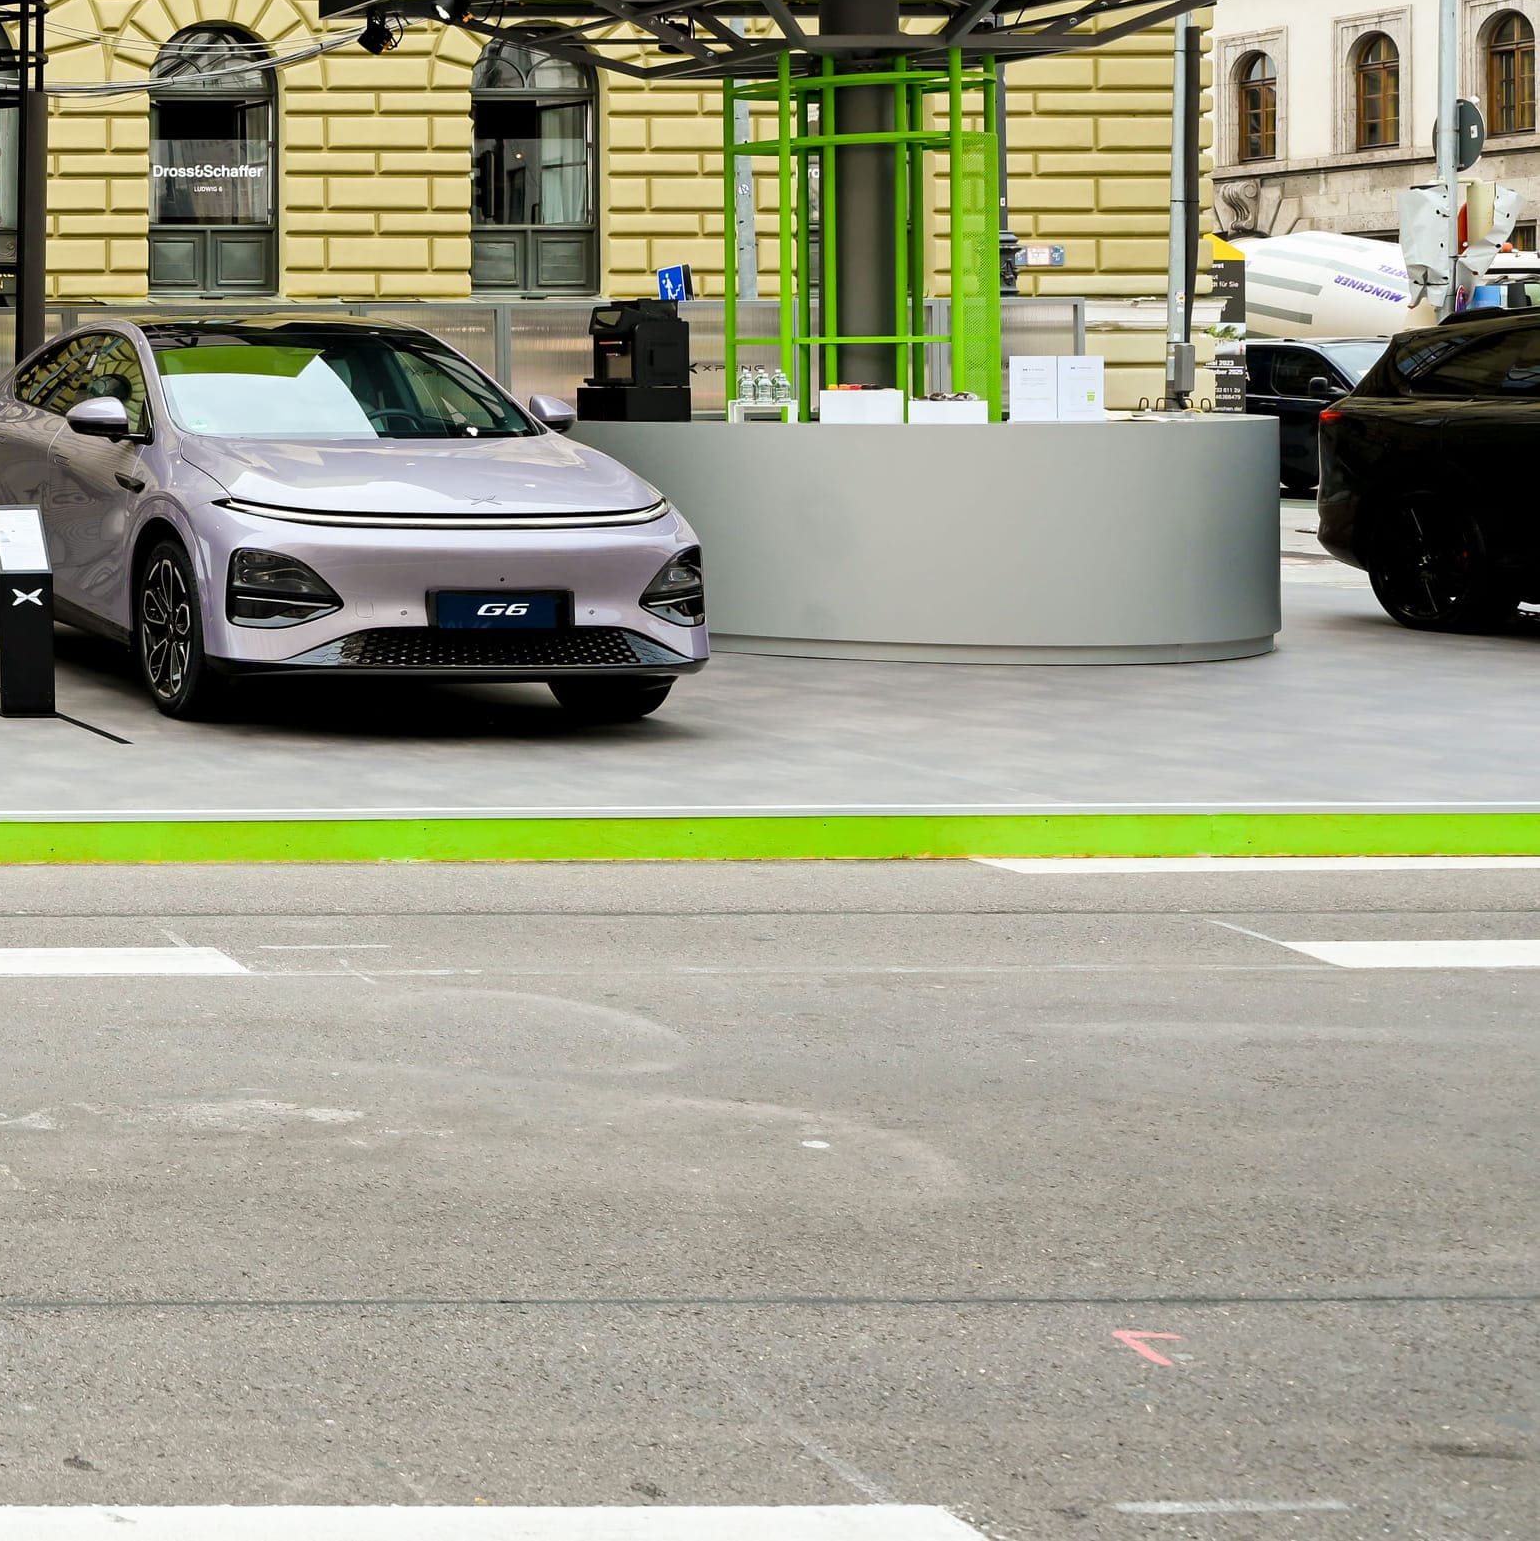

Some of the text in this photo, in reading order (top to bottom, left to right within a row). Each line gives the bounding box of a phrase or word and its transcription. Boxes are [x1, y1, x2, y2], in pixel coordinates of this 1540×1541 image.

[152, 164, 264, 178] Dross&Schaffer
[702, 364, 766, 372] XPNG
[476, 603, 530, 616] G6
